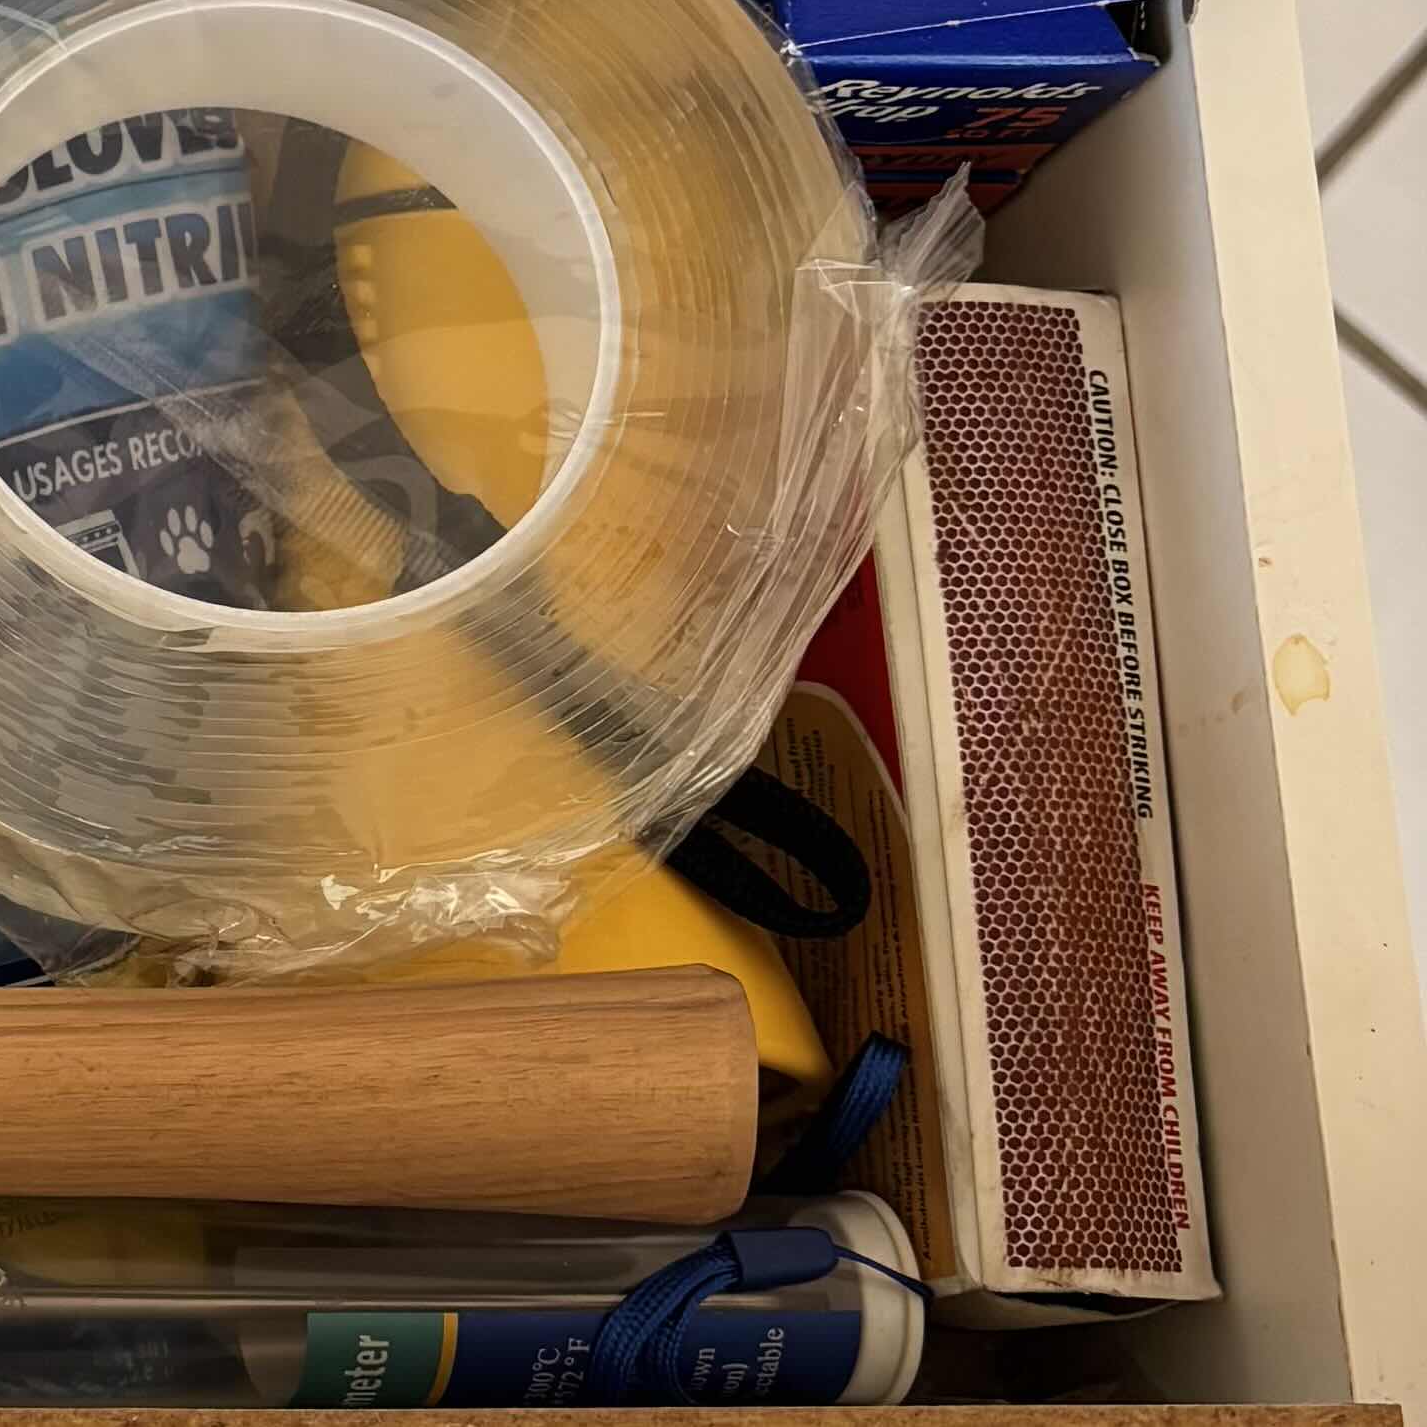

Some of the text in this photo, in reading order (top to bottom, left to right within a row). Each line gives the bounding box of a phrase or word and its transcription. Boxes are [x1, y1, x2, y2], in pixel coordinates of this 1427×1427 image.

[818, 79, 1103, 104] Reynolds
[962, 106, 1068, 128] 75
[12, 437, 124, 503] USAGES
[1088, 369, 1154, 819] CAUTION: CLOSE BOX BEFORE STRIKING
[1139, 882, 1192, 1237] KEEP AWAY FROM CHILDREN
